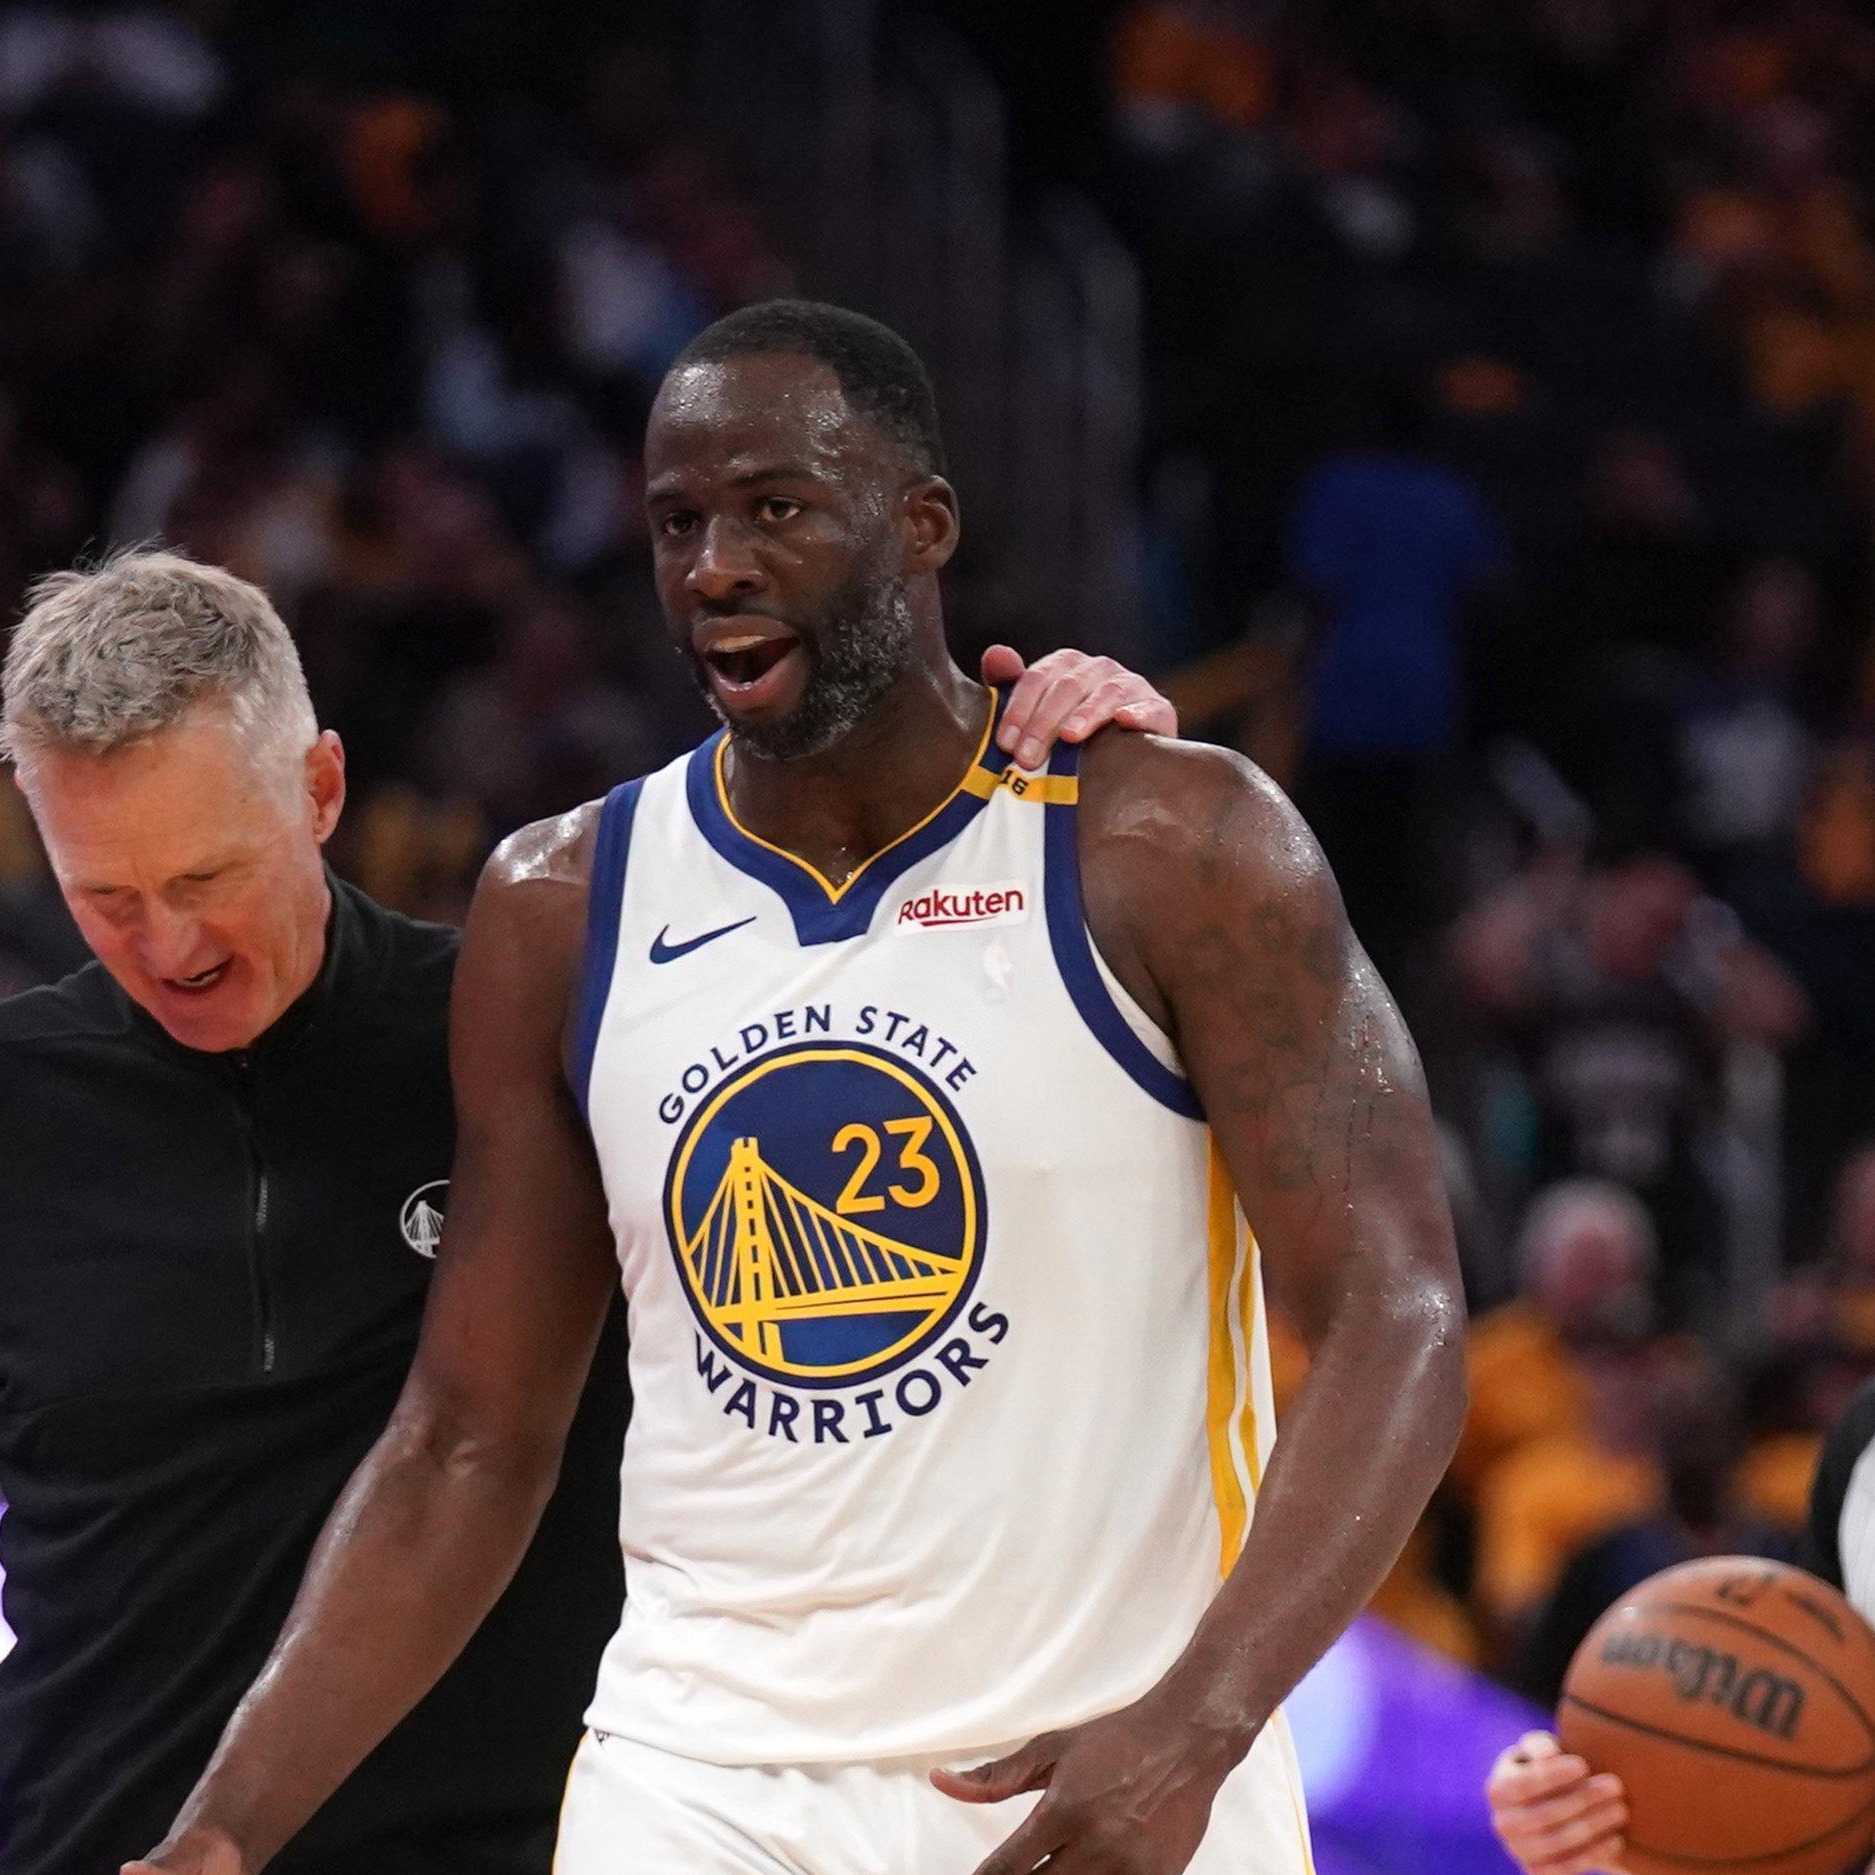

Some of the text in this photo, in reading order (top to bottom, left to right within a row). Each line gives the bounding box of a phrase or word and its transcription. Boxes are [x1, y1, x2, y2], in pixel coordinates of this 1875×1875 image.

[898, 889, 1024, 925] Rakuten
[659, 1004, 978, 1125] GOLDEN STATE
[831, 1115, 941, 1215] 23
[694, 1301, 1010, 1444] WARRIORS
